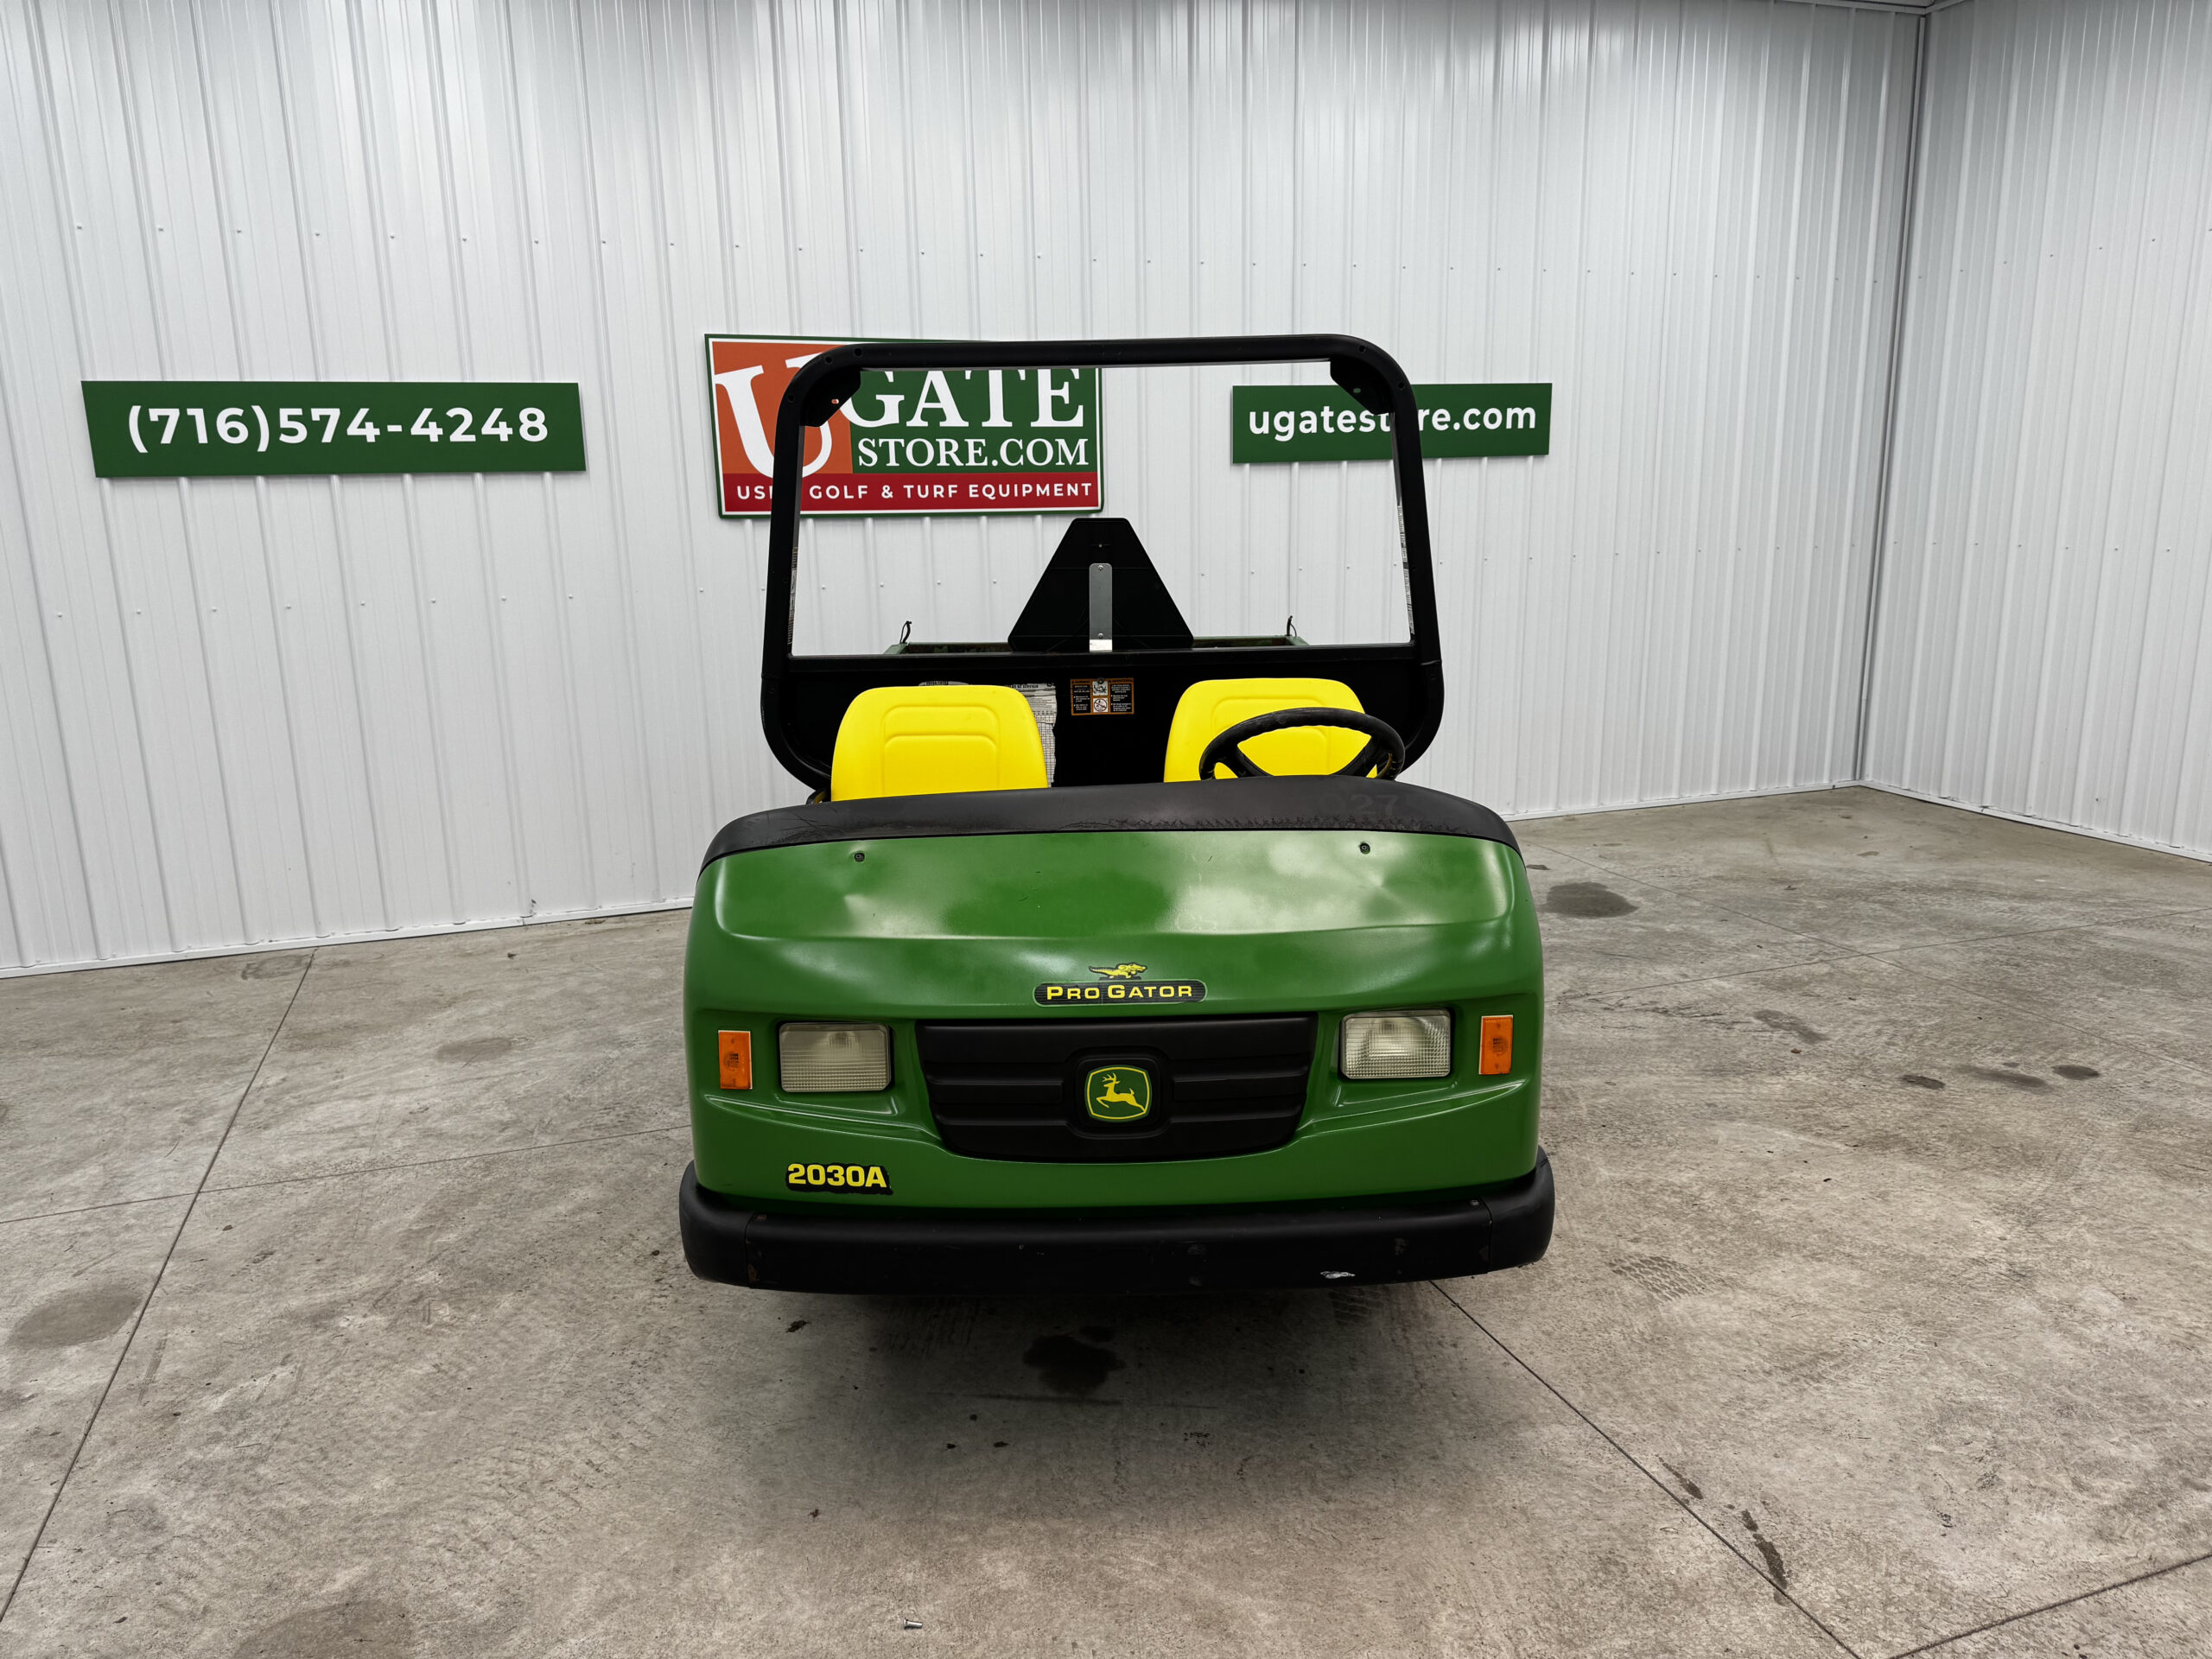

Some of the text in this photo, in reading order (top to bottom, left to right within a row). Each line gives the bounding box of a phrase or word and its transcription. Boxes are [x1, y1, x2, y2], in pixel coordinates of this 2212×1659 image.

[128, 404, 548, 454] (716)574-4248
[1249, 405, 1536, 442] ugatestre.com
[858, 437, 1090, 467] STORE.COM
[809, 485, 868, 499] GOLF
[880, 484, 893, 499] &
[904, 484, 958, 499] TURF
[969, 482, 1092, 500] EQUIPMENT
[1046, 984, 1192, 1001] PRO GATOR
[787, 1163, 887, 1188] 2030A
